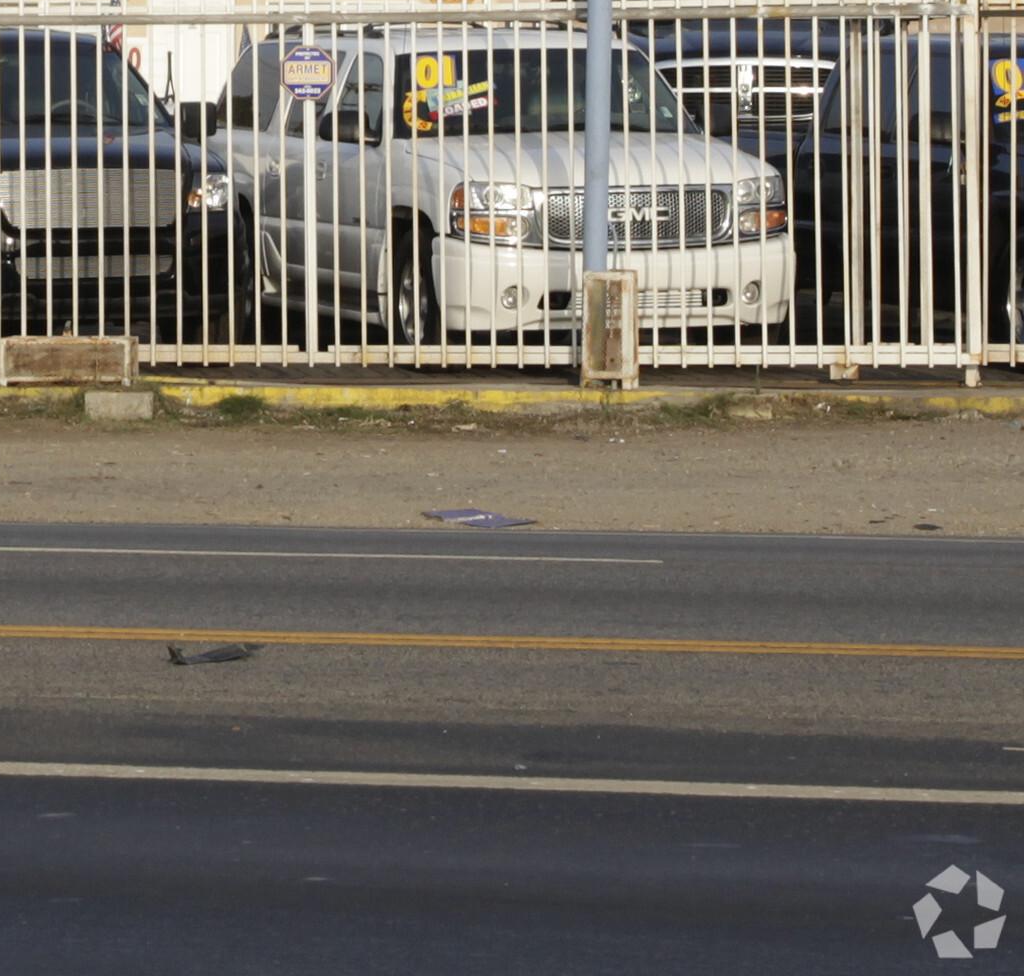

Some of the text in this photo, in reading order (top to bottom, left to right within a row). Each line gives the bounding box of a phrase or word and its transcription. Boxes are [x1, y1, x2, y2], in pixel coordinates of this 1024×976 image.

[287, 64, 328, 75] ARMET
[440, 97, 487, 116] OAED
[607, 206, 670, 222] GMC
